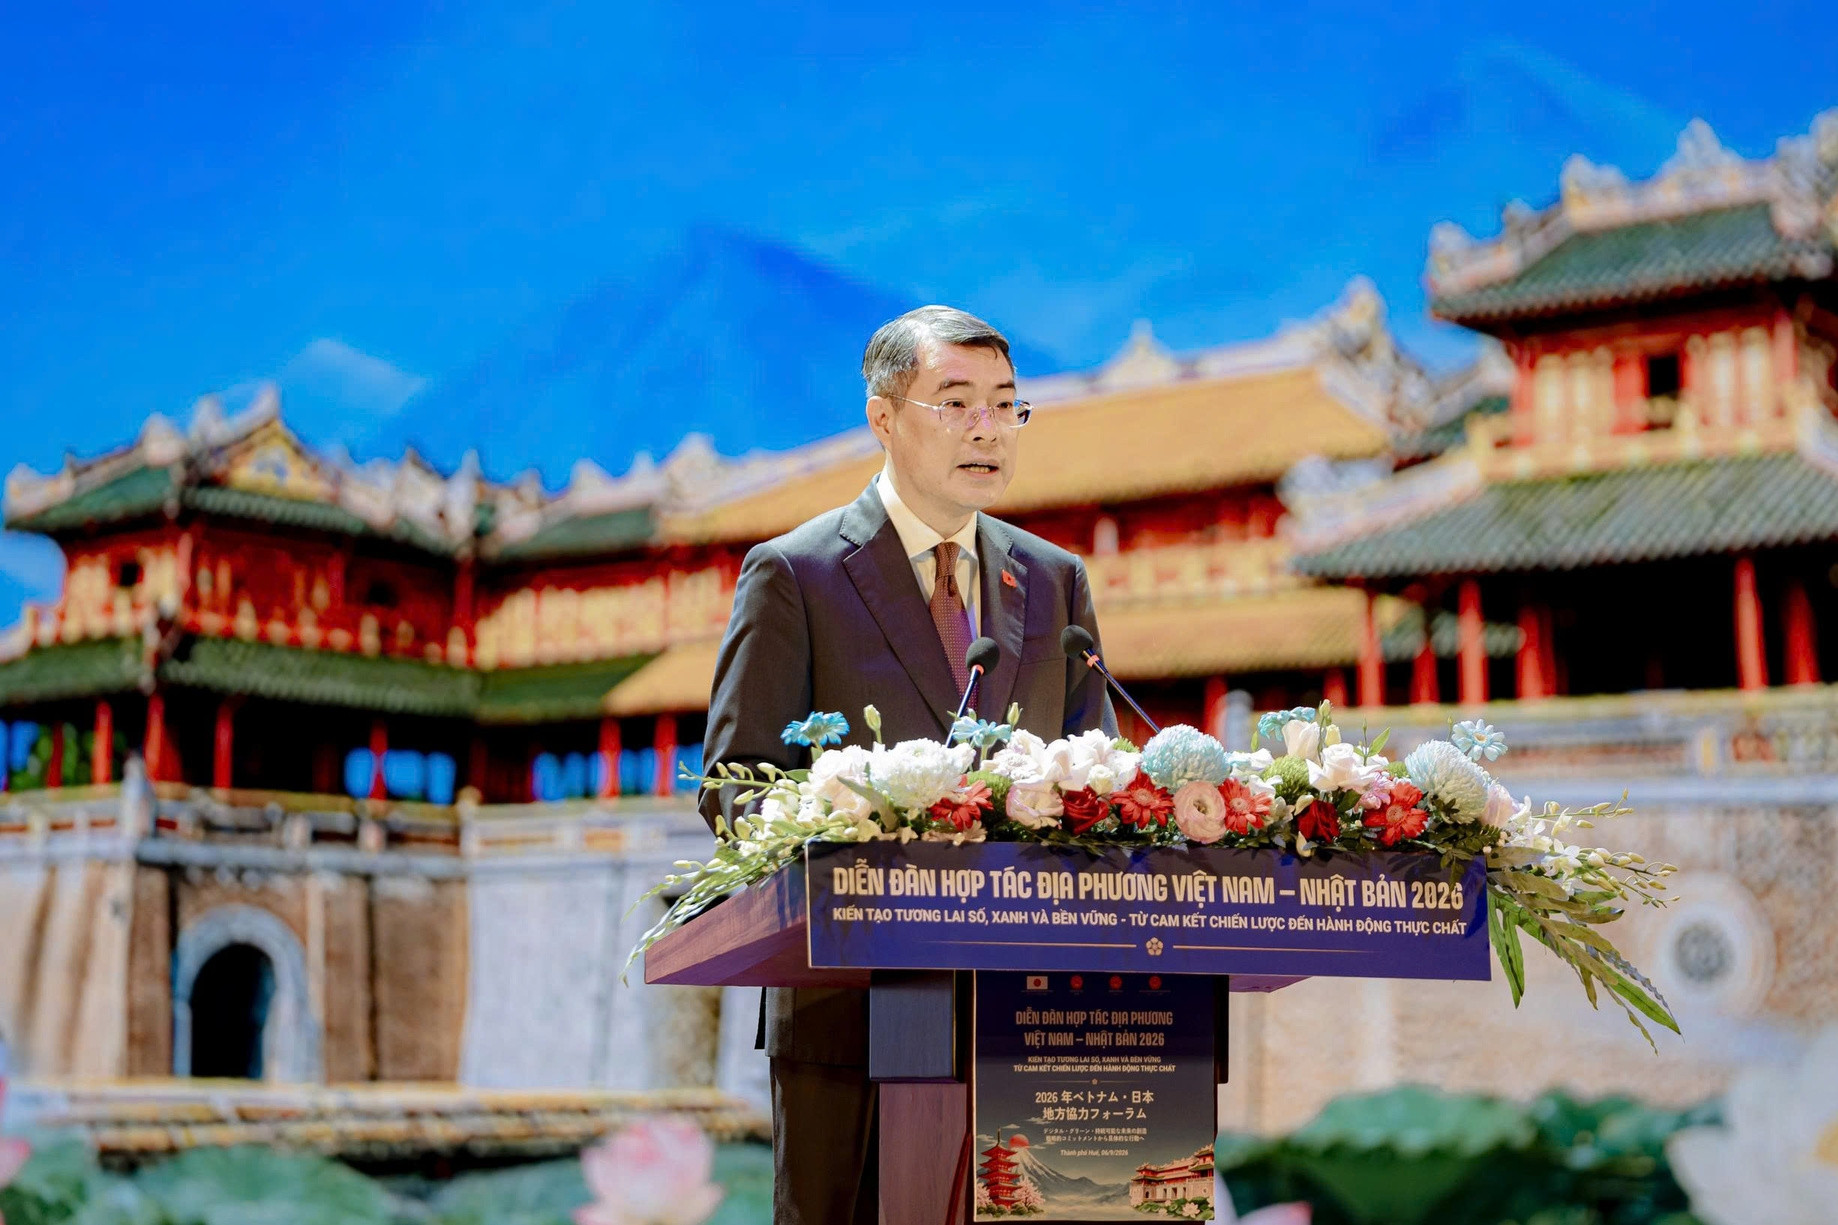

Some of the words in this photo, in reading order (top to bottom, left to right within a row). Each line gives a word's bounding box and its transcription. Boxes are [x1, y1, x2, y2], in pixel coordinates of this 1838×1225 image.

[833, 858, 884, 895] DIỄN
[889, 864, 936, 897] ĐÀN
[942, 869, 985, 904] HỢP
[990, 866, 1032, 899] TÁC
[1037, 871, 1073, 906] ĐỊA
[1079, 871, 1168, 901] PHƯƠNG
[1172, 869, 1217, 909] VIỆT
[1222, 876, 1275, 904] NAM
[1301, 874, 1356, 912] NHẬT
[1362, 874, 1406, 908] BẢN
[1412, 881, 1464, 910] 2026
[833, 904, 864, 921] KIẾN
[866, 907, 892, 924] TẠO
[895, 907, 941, 922] TƯƠNG
[945, 909, 965, 923] LAI
[968, 907, 989, 926] SỐ,
[992, 910, 1028, 924] XANH
[1031, 908, 1049, 924] VÀ
[1053, 908, 1078, 925] BỀN
[1080, 908, 1117, 926] VỮNG
[1130, 911, 1148, 926] TỪ
[1150, 914, 1180, 927] CAM
[1183, 911, 1206, 928] KẾT
[1209, 912, 1248, 929] CHIẾN
[1251, 915, 1285, 933] LƯỢC
[1288, 913, 1314, 930] ĐẾN
[1317, 915, 1353, 931] HÀNH
[1356, 916, 1391, 935] ĐỘNG
[1394, 919, 1430, 936] THỰC
[1433, 918, 1467, 935] CHẤT
[1016, 1007, 1039, 1025] DIỄN
[1042, 1009, 1063, 1025] ĐÀN
[1066, 1010, 1087, 1028] HỢP
[1089, 1009, 1109, 1025] TÁC
[1111, 1011, 1129, 1028] ĐỊA
[1131, 1010, 1173, 1026] PHƯƠNG
[1024, 1029, 1046, 1049] VIỆT
[1048, 1032, 1074, 1046] NAM
[1085, 1030, 1113, 1049] NHẬT
[1115, 1029, 1137, 1046] BẢN
[1139, 1032, 1165, 1046] 2026
[1023, 1064, 1038, 1072] CAM
[1035, 1091, 1058, 1104] 2026
[1061, 1090, 1154, 1105] 年ベトナム・日本
[1043, 1106, 1147, 1121] 地方協力フォーラム
